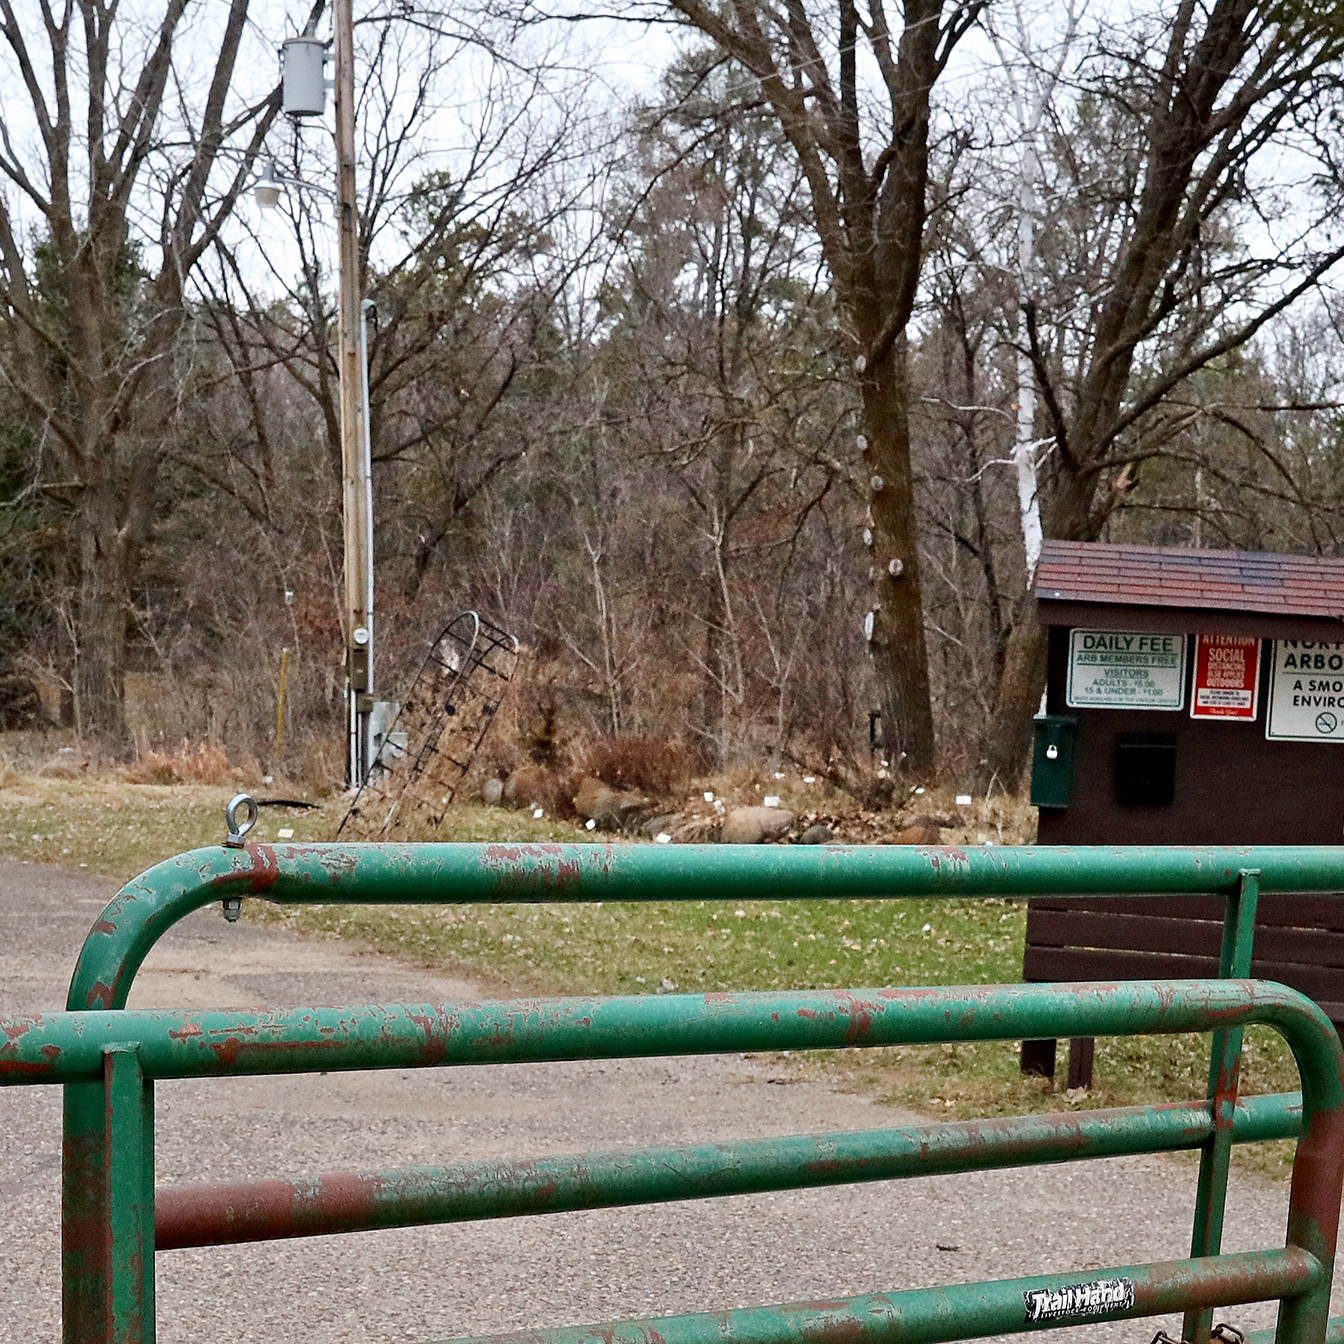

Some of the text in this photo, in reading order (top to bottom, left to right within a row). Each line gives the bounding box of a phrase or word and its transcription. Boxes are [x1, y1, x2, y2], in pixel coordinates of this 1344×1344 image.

[1083, 635, 1173, 652] DAILY FEE
[1202, 635, 1256, 646] ATTENTION
[1076, 653, 1177, 664] ARB MEMBERS FREE
[1209, 648, 1245, 661] SOCIAL
[1104, 668, 1149, 678] VISITORS
[1092, 678, 1127, 687] ADULTS
[1293, 680, 1303, 691] A
[1084, 686, 1093, 694] 15
[1105, 687, 1136, 695] UNDER
[1032, 1281, 1124, 1320] Trail Hand
